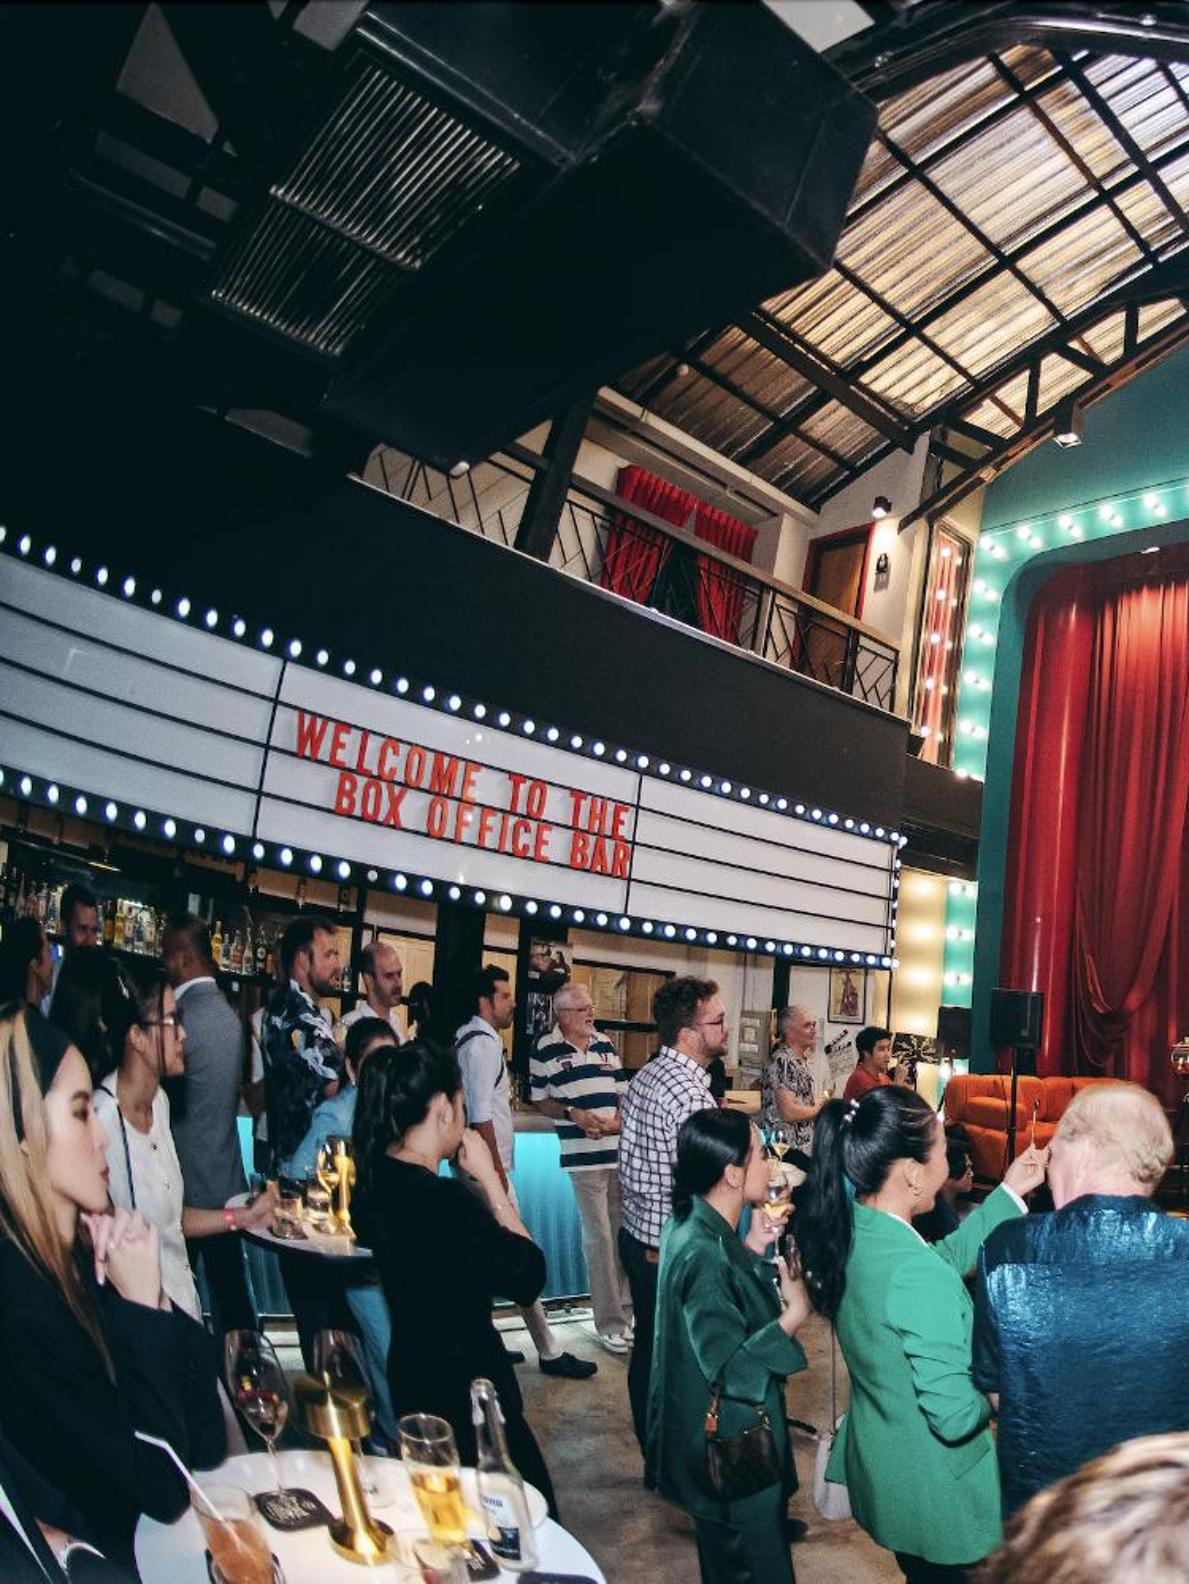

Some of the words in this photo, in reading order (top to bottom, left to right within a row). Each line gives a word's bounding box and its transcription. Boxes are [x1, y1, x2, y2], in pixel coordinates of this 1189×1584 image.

[296, 710, 483, 804] WELCOME
[509, 773, 547, 820] TO
[570, 790, 631, 842] THE
[334, 770, 407, 829] BOX
[426, 795, 552, 864] OFFICE
[569, 830, 632, 880] BAR
